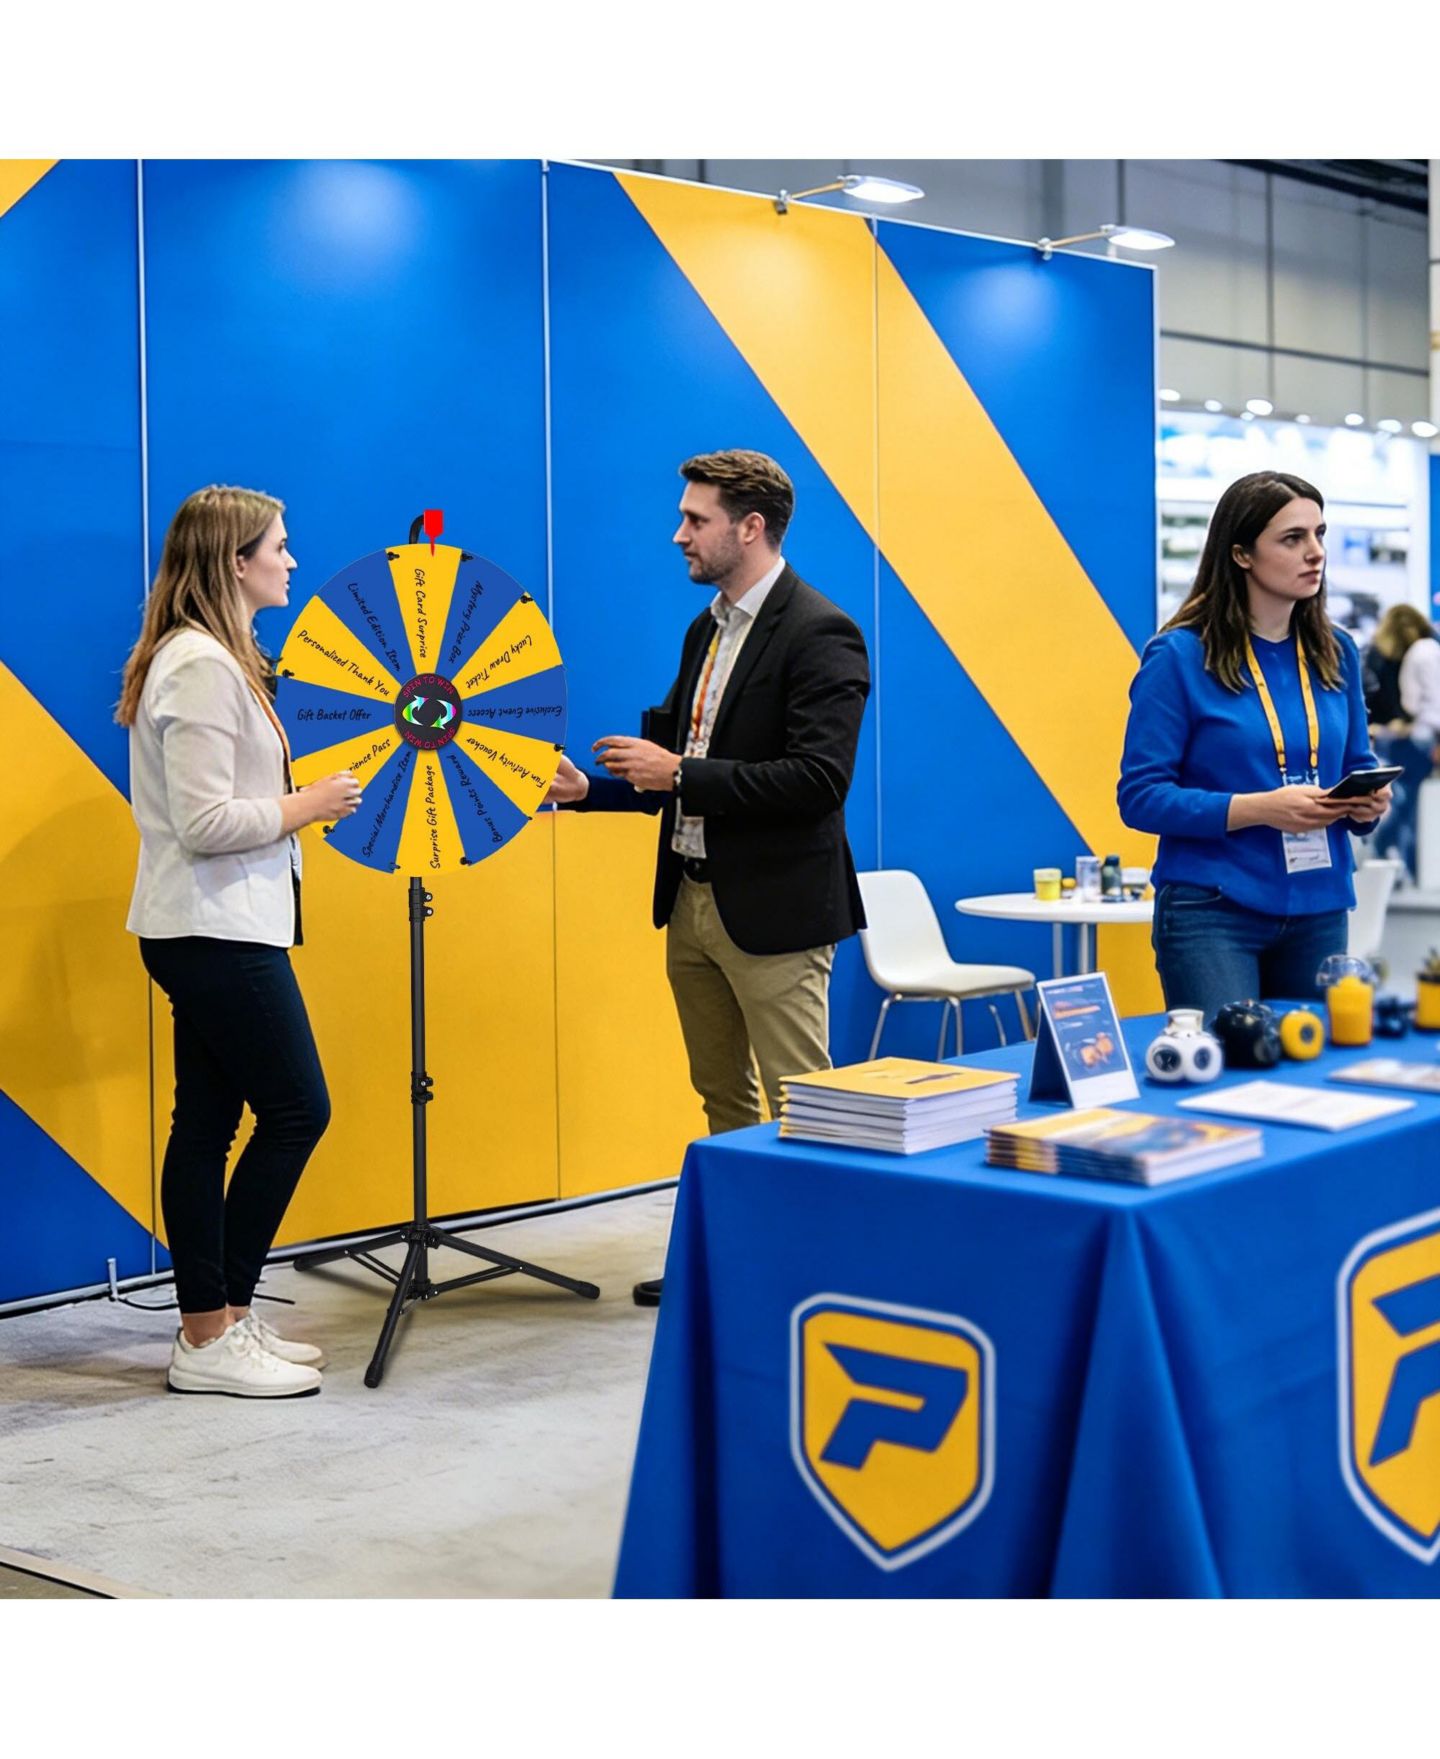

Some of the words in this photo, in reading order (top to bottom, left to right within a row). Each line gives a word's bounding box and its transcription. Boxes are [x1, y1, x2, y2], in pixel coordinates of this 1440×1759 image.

[414, 568, 426, 586] Gift
[416, 591, 426, 616] Card
[462, 581, 484, 620] Mystery
[347, 582, 372, 615] Limited
[367, 615, 387, 649] Edition
[386, 649, 400, 672] Item
[416, 618, 428, 658] Surprise
[448, 645, 462, 664] Box
[510, 634, 532, 654] Lucky
[297, 630, 348, 667] Personalized
[348, 662, 374, 685] Thank
[374, 680, 390, 696] You
[490, 652, 511, 670] Draw
[423, 676, 434, 684] TO
[466, 668, 490, 689] Ticket
[297, 708, 314, 721] Gift
[316, 708, 348, 721] Basket
[350, 709, 372, 720] Offer
[468, 708, 496, 719] Access
[498, 707, 524, 718] Event
[526, 706, 563, 716] Exclusive
[348, 754, 372, 771] rience
[372, 738, 390, 757] Pass
[424, 741, 436, 749] TO
[466, 738, 498, 761] Voucher
[446, 754, 472, 787] Reward
[499, 753, 530, 778] Activity
[425, 765, 436, 804] Package
[531, 775, 546, 788] Fun
[362, 828, 379, 858] Special
[400, 750, 412, 774] Item
[468, 788, 487, 816] Points
[427, 806, 438, 826] Gift
[484, 818, 502, 843] Bonus
[430, 829, 440, 869] Surprise
